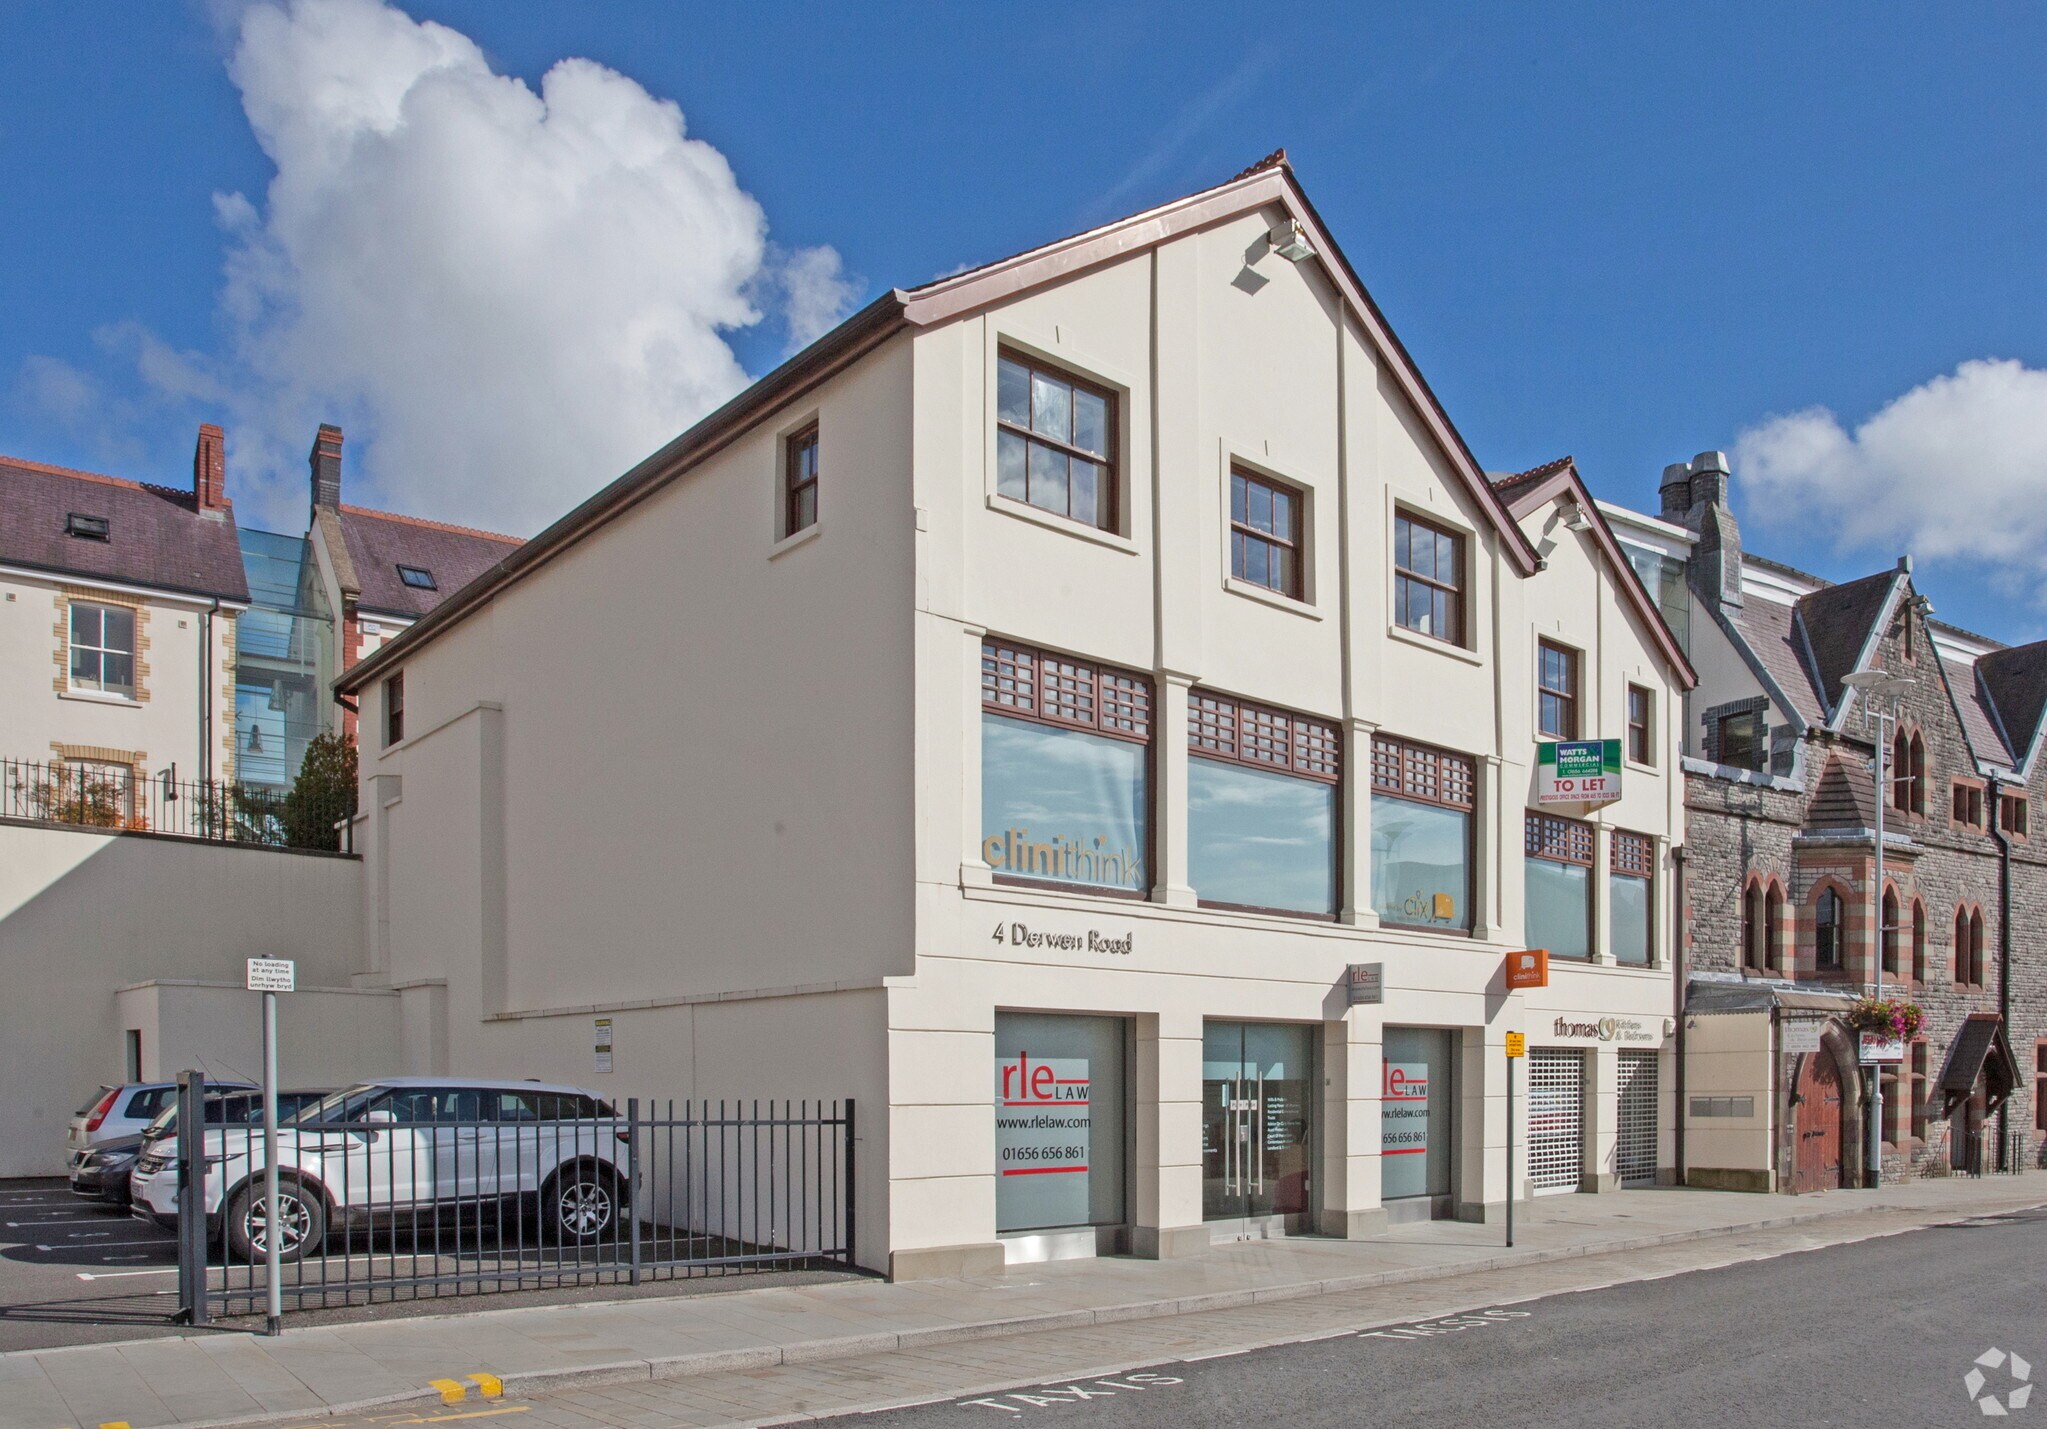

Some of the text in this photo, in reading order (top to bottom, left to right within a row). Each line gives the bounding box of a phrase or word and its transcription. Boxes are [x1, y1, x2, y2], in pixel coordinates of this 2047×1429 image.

[1559, 748, 1587, 756] WATTS
[1559, 755, 1600, 763] MORGAN
[1554, 778, 1606, 792] TO LET
[983, 827, 1143, 883] clinithink
[992, 921, 1132, 954] 4 Derwen Road
[264, 961, 289, 969] loading
[1352, 966, 1368, 981] rle
[1553, 1016, 1599, 1038] thomas
[1003, 1051, 1090, 1100] rle LAW
[1405, 1085, 1427, 1096] LAW
[997, 1115, 1091, 1129] www.rlelaw.com
[1398, 1132, 1412, 1143] 656
[1413, 1131, 1426, 1142] 861
[1003, 1146, 1084, 1160] 01656 656 861
[1357, 1310, 1531, 1340] TACSIS
[957, 1373, 1184, 1412] TAXIS
